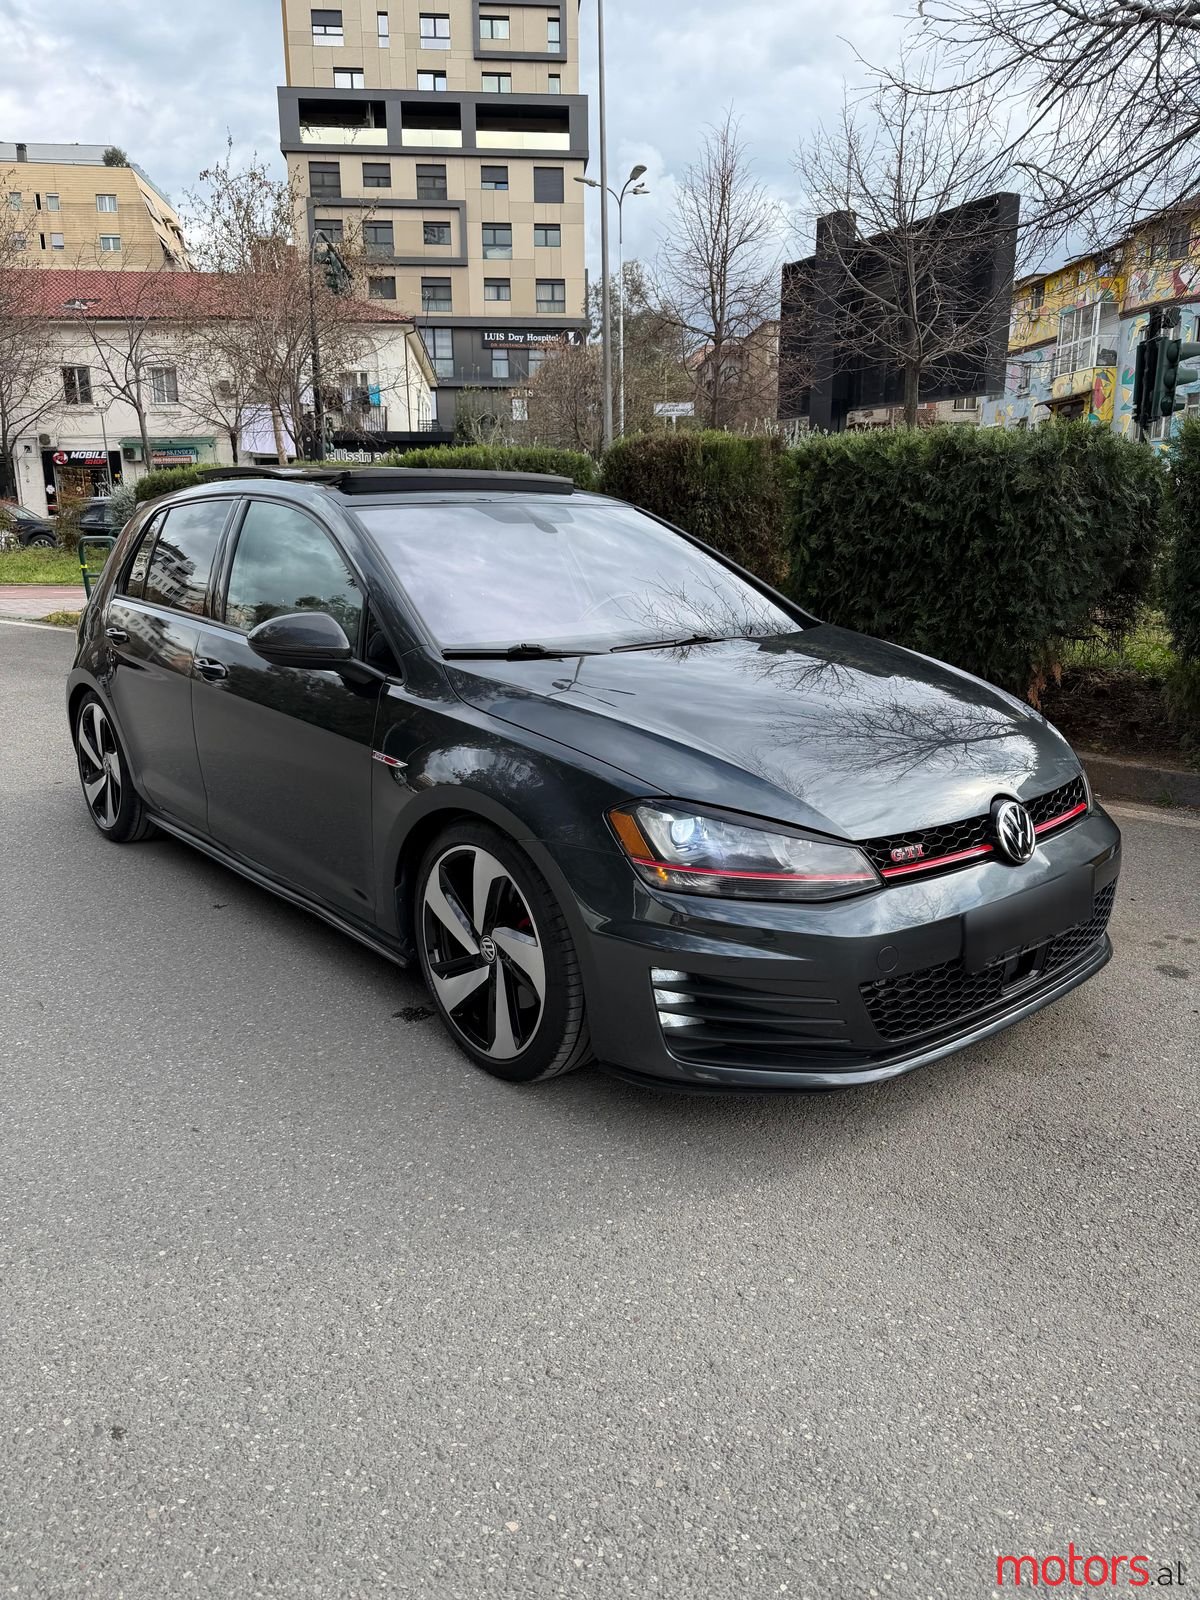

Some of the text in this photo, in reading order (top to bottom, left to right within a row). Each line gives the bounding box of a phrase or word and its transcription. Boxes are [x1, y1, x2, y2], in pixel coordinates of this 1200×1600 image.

[484, 332, 559, 343] LUIS Day Hospital
[70, 451, 108, 459] MOBILE
[890, 843, 925, 862] GTI
